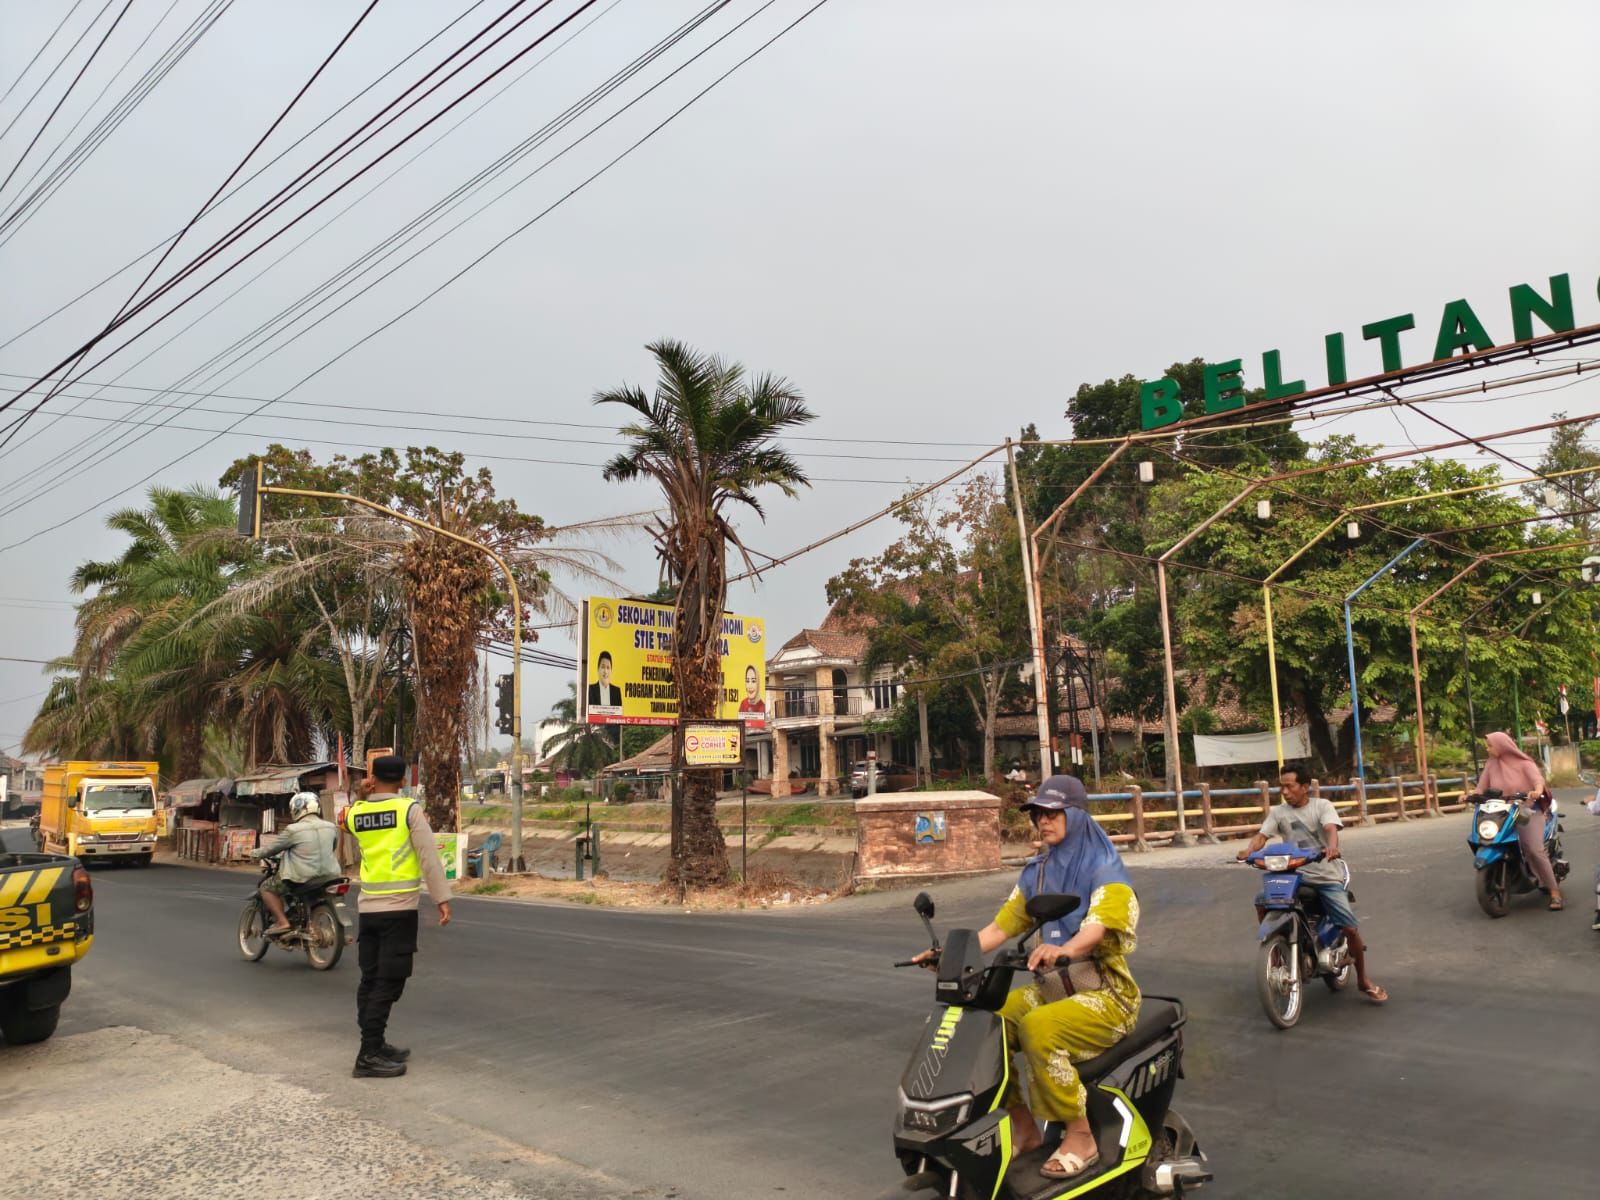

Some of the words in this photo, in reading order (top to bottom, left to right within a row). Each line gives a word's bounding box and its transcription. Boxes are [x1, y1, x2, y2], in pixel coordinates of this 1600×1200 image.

[1141, 273, 1600, 431] BELITAN
[618, 605, 656, 626] SEKOLAH
[634, 630, 655, 649] STIE
[625, 682, 654, 698] PROGRAM
[354, 811, 396, 830] POLISI
